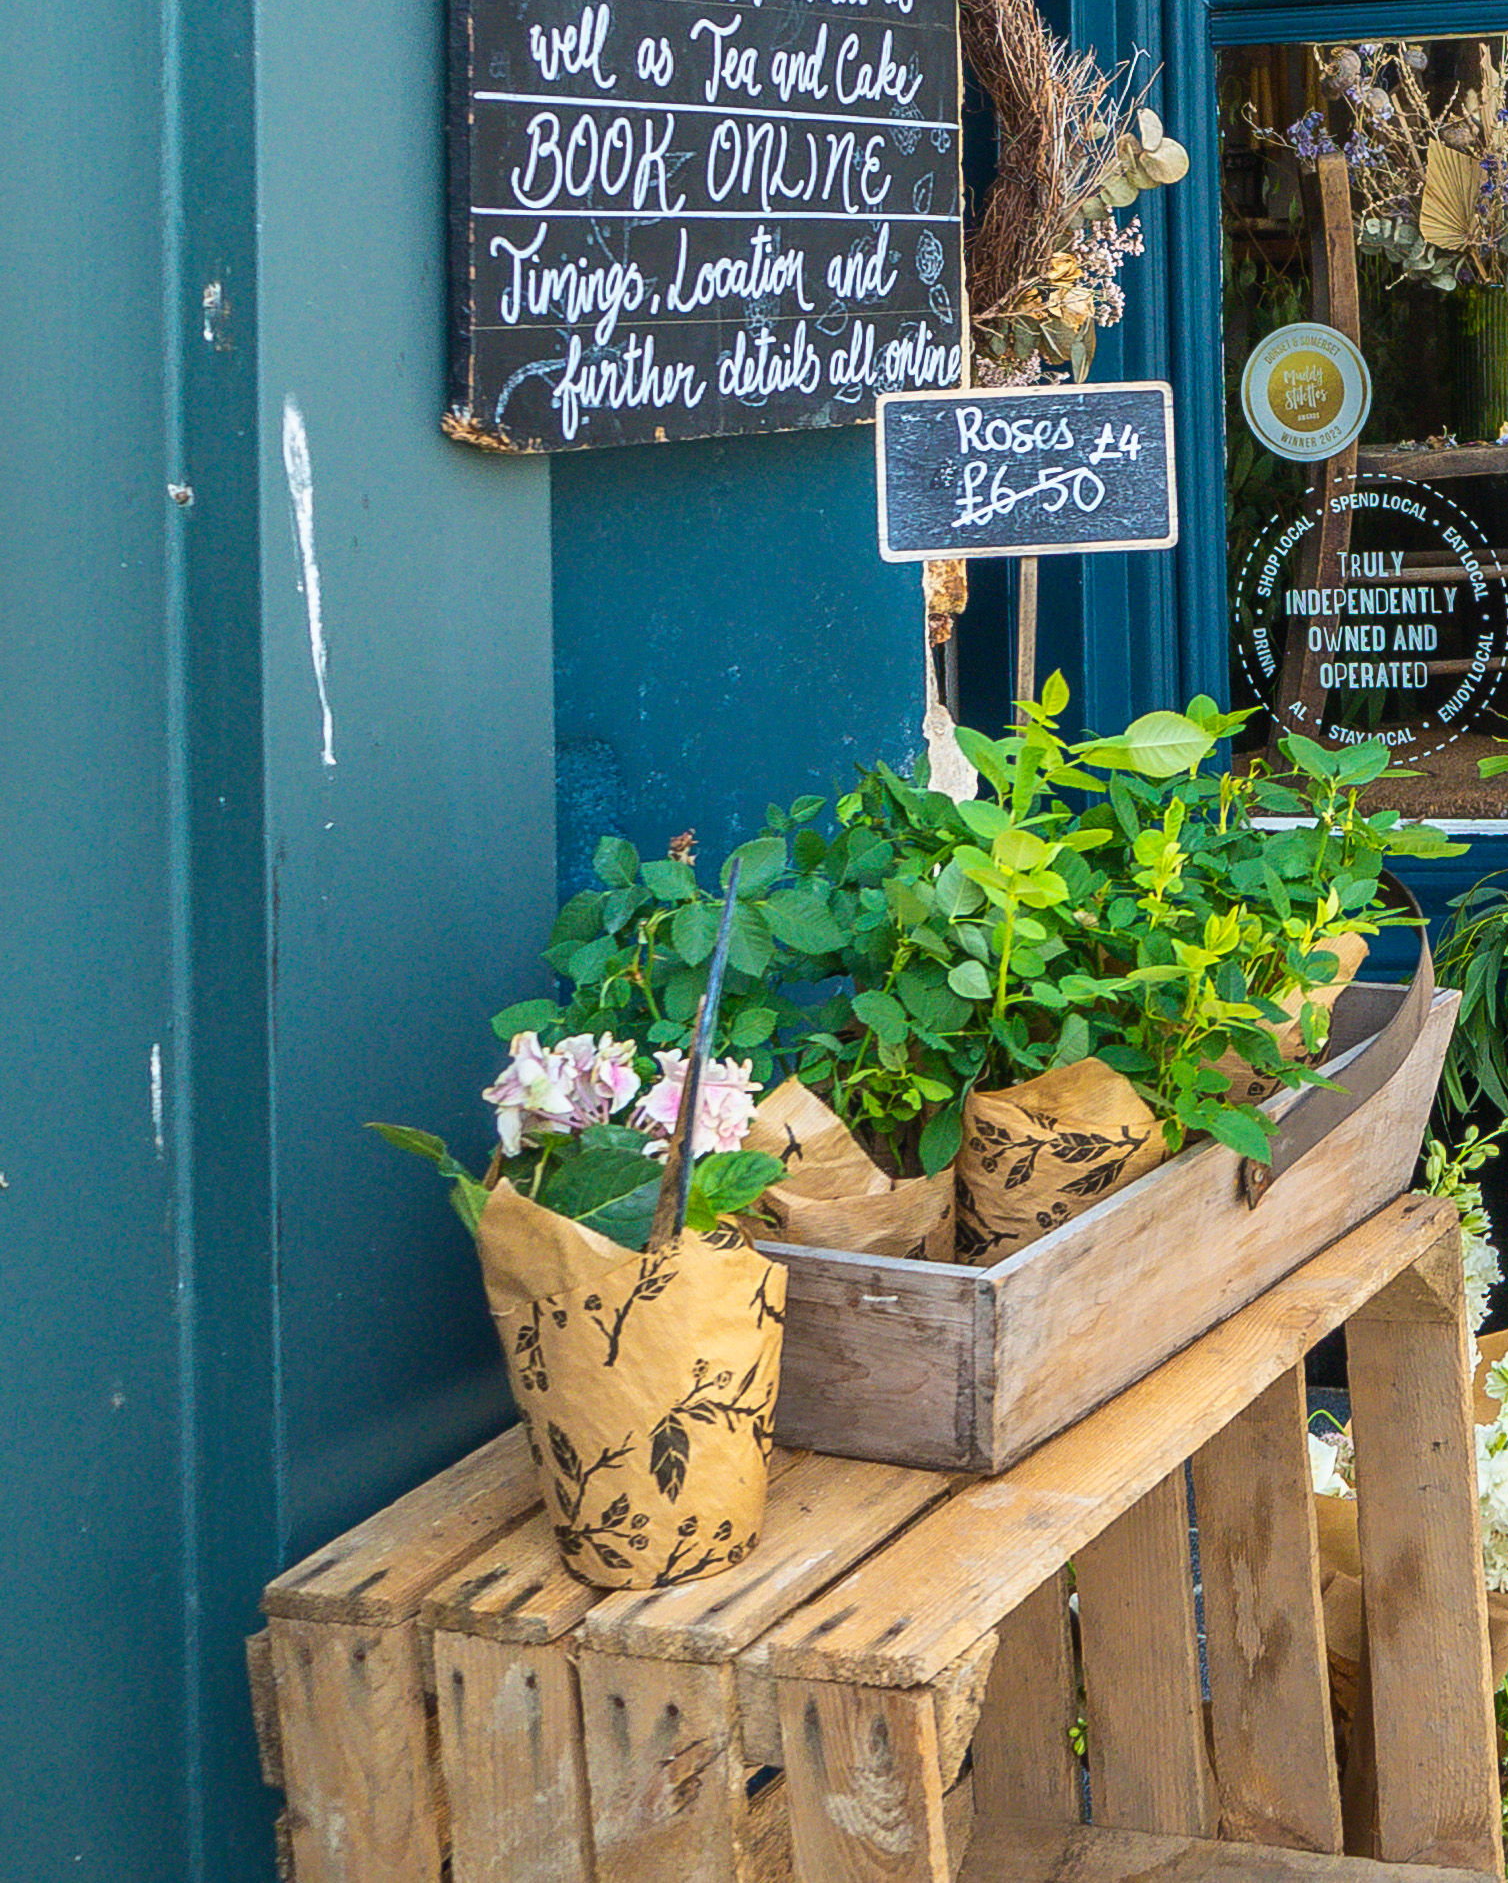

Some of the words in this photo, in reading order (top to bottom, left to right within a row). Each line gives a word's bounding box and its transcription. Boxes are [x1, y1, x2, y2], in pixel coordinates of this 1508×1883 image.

[530, 3, 617, 89] well
[637, 35, 675, 87] as
[690, 14, 762, 102] Tea
[771, 24, 829, 102] and
[835, 30, 924, 105] Cake
[511, 111, 687, 214] BOOK
[707, 119, 893, 214] ONLINE
[491, 222, 661, 347] Timings,
[667, 227, 815, 315] Location
[827, 222, 898, 298] and
[1264, 339, 1291, 364] DORSET
[1301, 336, 1342, 357] SOMERSET
[555, 325, 707, 441] further
[718, 319, 821, 394] details
[829, 319, 877, 386] all
[886, 321, 962, 387] online
[1283, 364, 1324, 386] Muddy
[955, 406, 1076, 454] Roses
[1089, 423, 1142, 465] £4
[1281, 431, 1317, 448] WINNER
[1319, 425, 1342, 445] 2023
[1330, 492, 1380, 514] SPEND
[1382, 494, 1427, 522] LOCAL
[1257, 554, 1279, 599] SHOP
[1281, 515, 1315, 557] LOCAL
[1336, 551, 1405, 578] TRULY
[1442, 526, 1469, 554] EAT
[1460, 550, 1489, 603] LOCAL
[1285, 587, 1458, 616] INDEPENDENTLY
[1308, 625, 1386, 652] OWNED
[1393, 624, 1438, 652] AND
[1320, 662, 1428, 689] OPERATED
[1437, 680, 1473, 723] ENJOY
[1470, 631, 1495, 682] LOCAL
[1329, 725, 1363, 745] STAY
